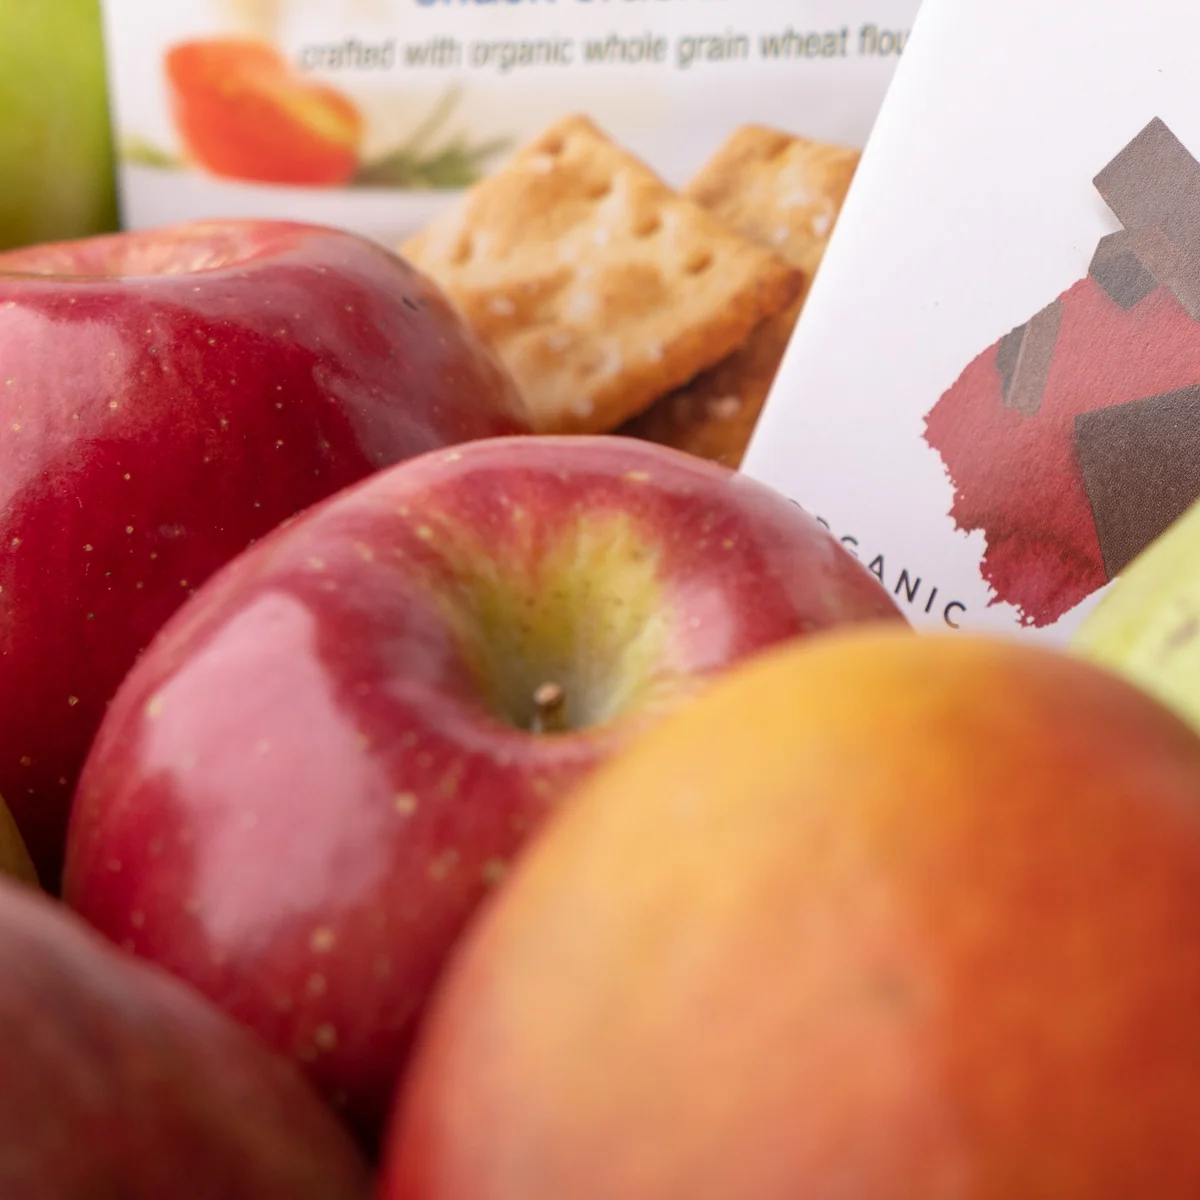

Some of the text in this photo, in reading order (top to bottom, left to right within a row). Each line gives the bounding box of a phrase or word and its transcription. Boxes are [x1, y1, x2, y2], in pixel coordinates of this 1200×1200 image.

[402, 34, 463, 67] with
[470, 31, 576, 74] organic
[582, 29, 670, 66] whole
[677, 28, 752, 66] grain
[758, 23, 850, 62] wheat
[857, 20, 912, 58] flou
